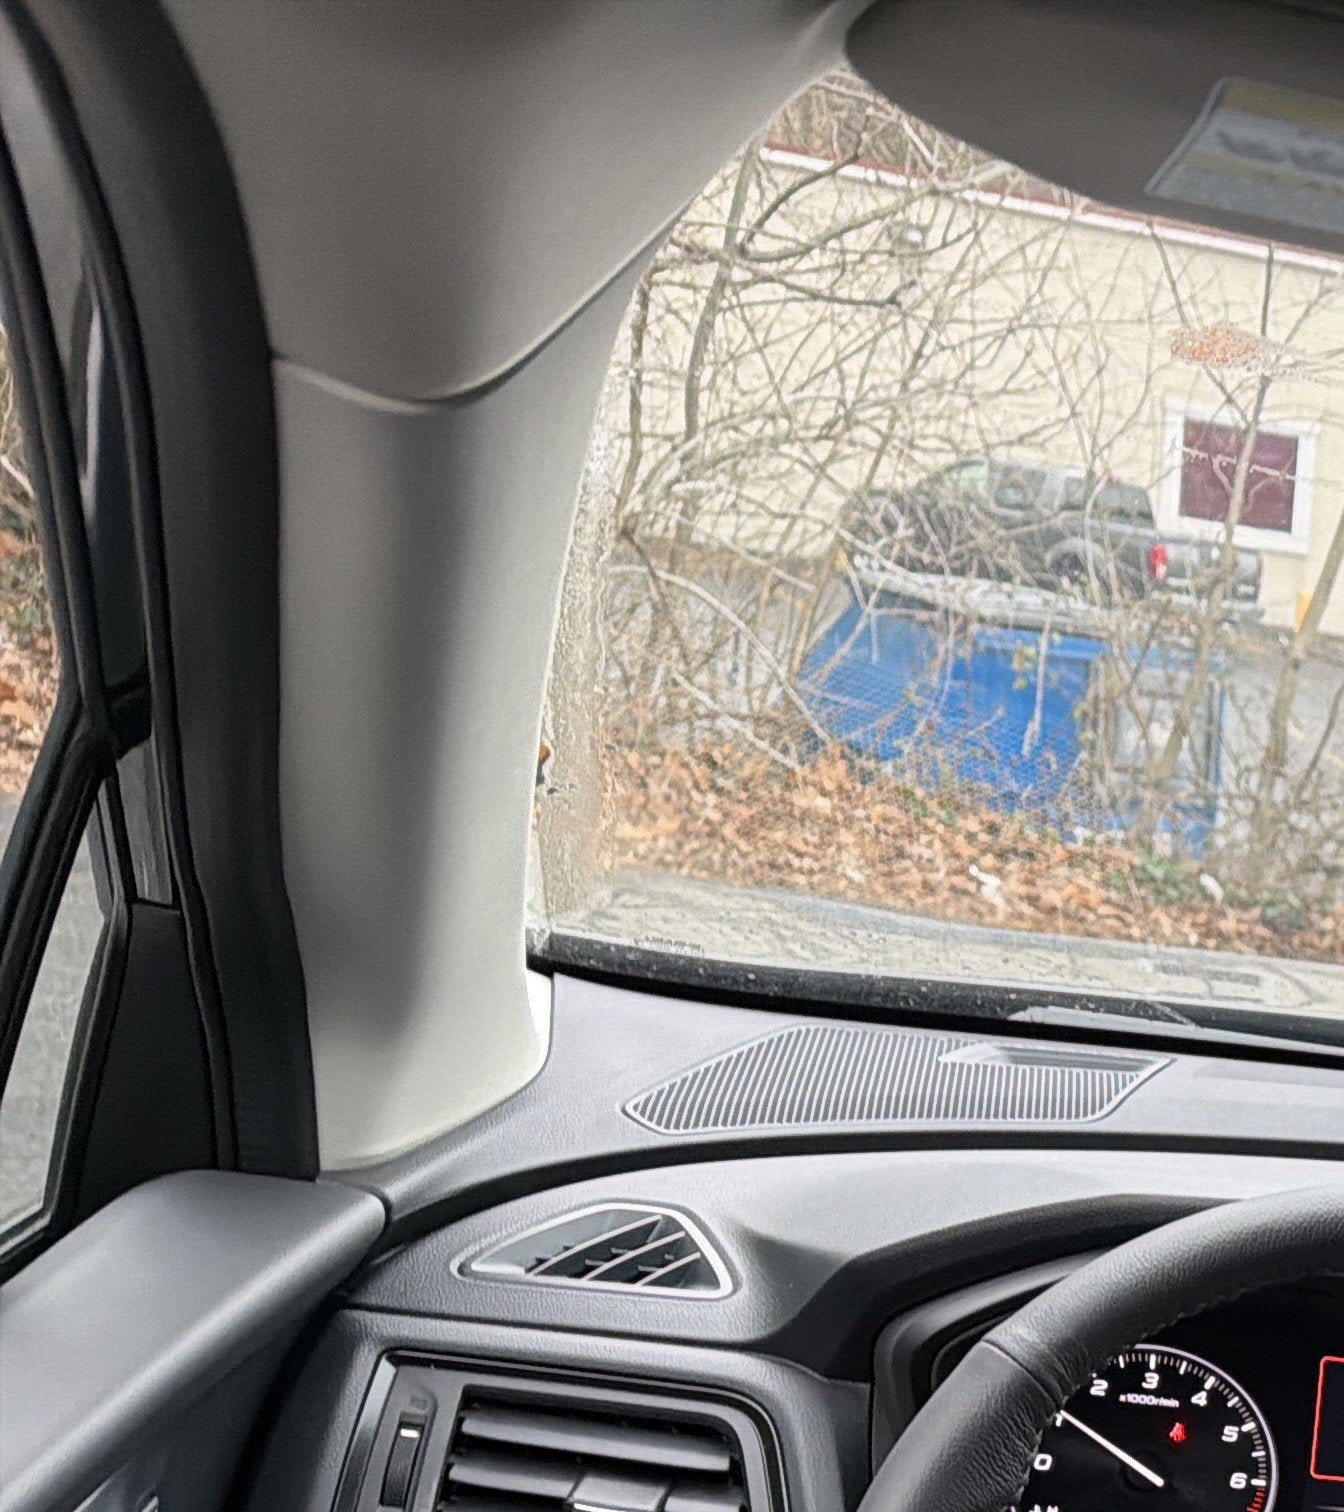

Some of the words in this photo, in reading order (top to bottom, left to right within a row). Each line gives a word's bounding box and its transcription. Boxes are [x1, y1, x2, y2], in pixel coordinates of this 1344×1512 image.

[1090, 1379, 1108, 1397] 2
[1142, 1372, 1159, 1389] 3
[1191, 1390, 1208, 1407] 4
[1222, 1425, 1240, 1442] 5
[1034, 1453, 1053, 1471] 0
[1230, 1472, 1248, 1489] 6
